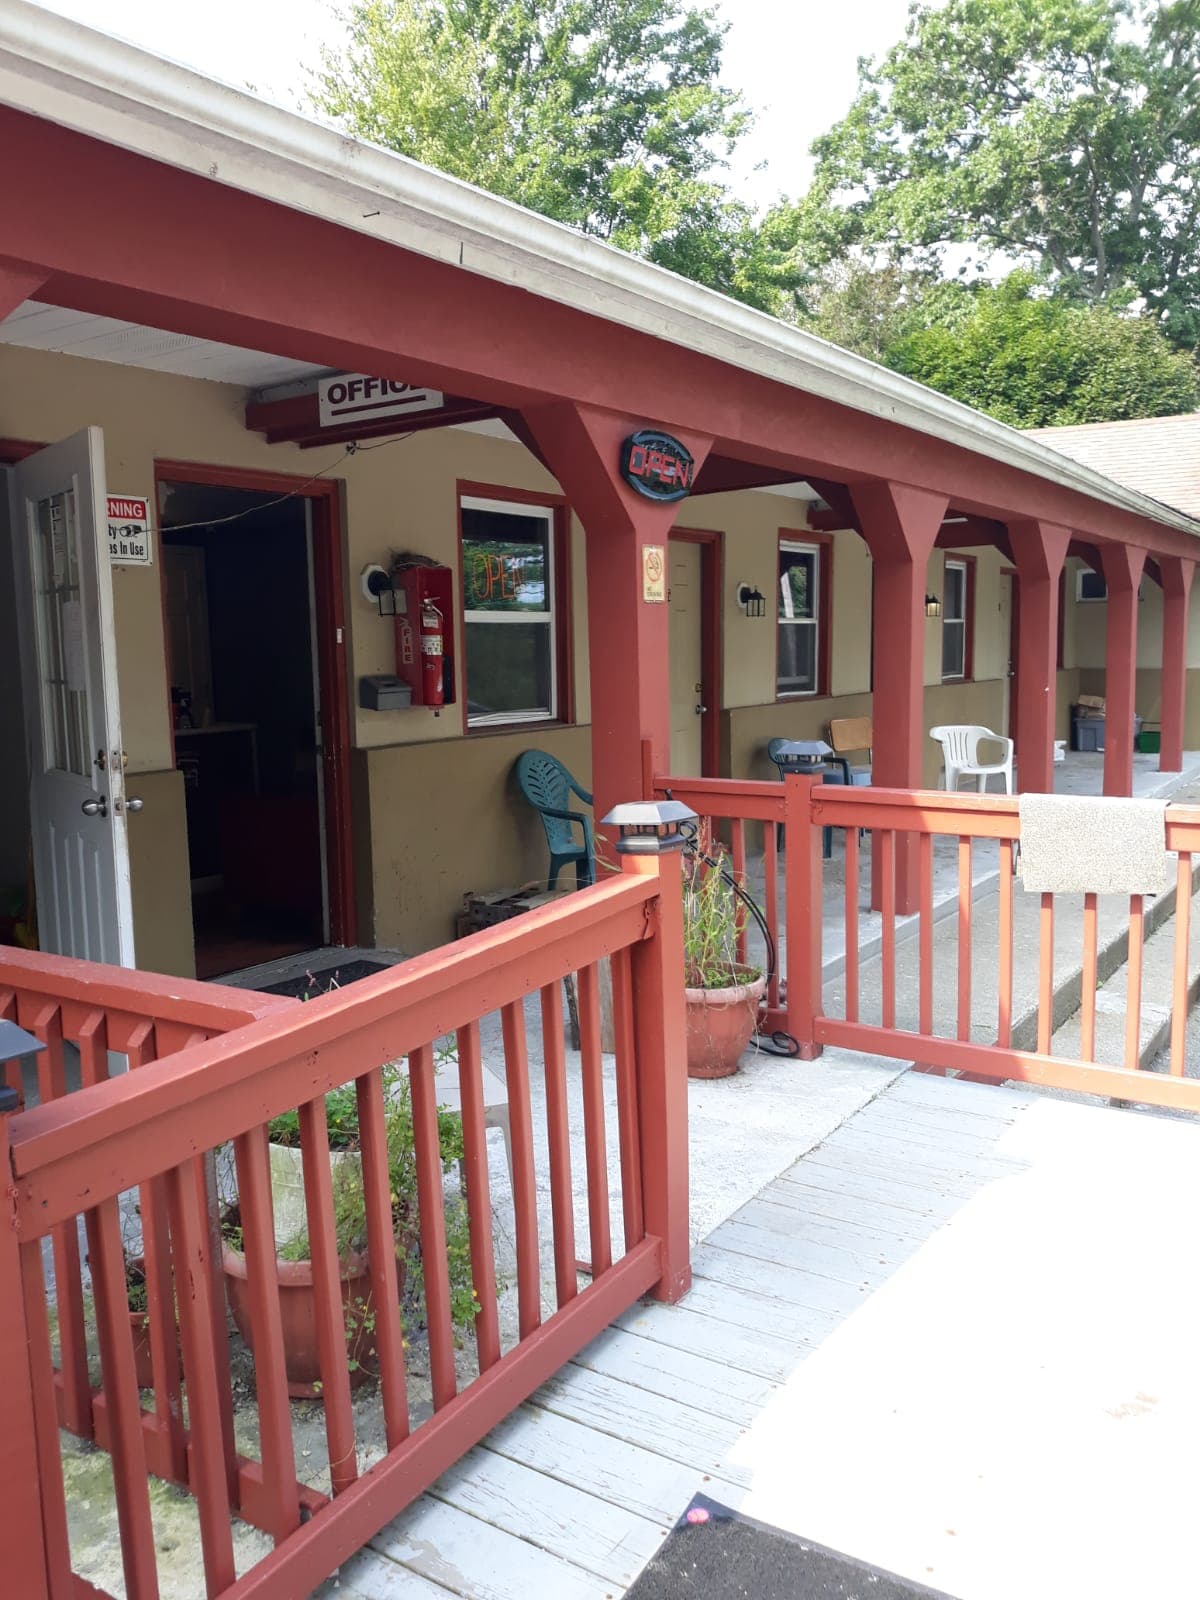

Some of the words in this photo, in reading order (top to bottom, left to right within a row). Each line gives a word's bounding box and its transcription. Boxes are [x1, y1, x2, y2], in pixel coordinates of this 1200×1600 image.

[327, 378, 423, 404] OFFIC
[629, 445, 690, 488] OPEN
[130, 541, 144, 556] Use
